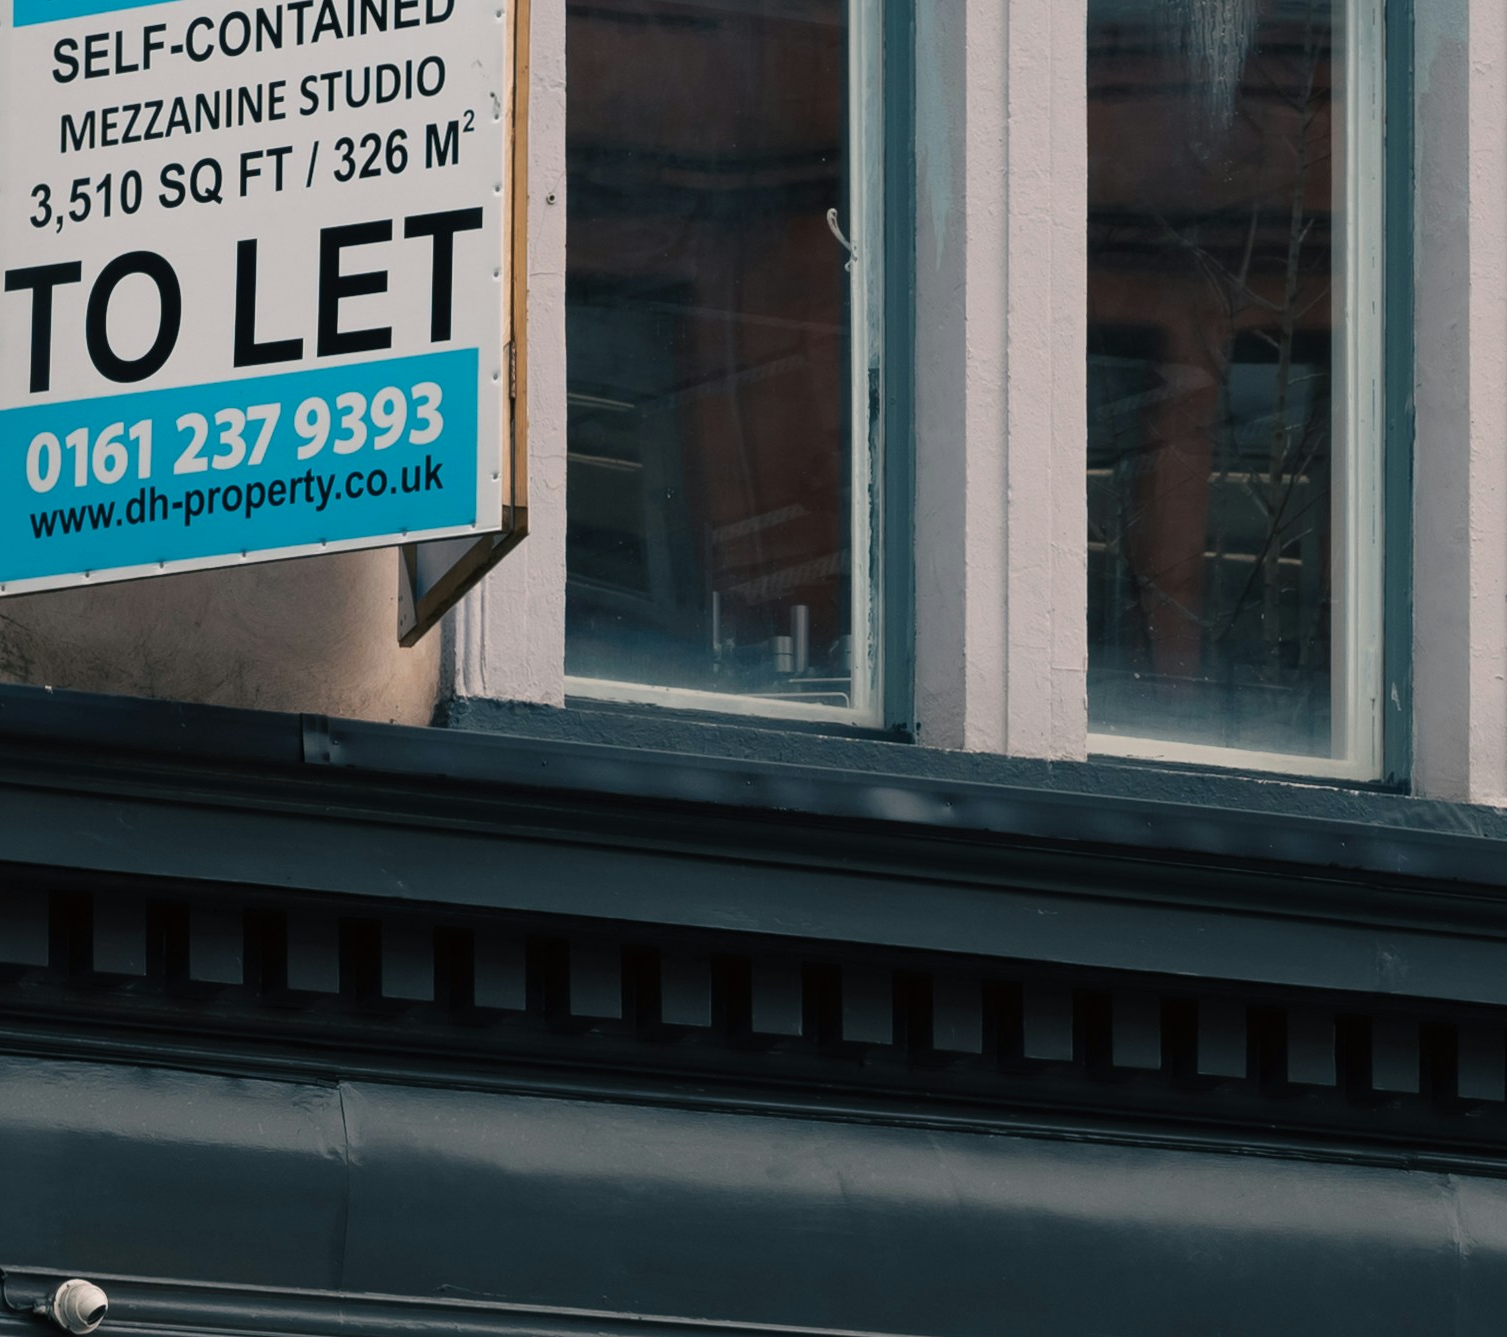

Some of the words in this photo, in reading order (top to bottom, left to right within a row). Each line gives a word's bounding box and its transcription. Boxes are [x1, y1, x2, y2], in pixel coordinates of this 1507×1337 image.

[52, 0, 454, 84] SELF-CONTAINED
[60, 80, 287, 154] MEZZANINE
[299, 55, 446, 116] STUDIO
[29, 169, 143, 234] 3,510
[158, 157, 224, 210] SQ
[239, 145, 293, 198] FT
[305, 141, 320, 188] /
[333, 128, 409, 183] 326
[4, 250, 182, 394] TO
[233, 206, 484, 369] LET
[25, 418, 153, 494] 0161
[173, 402, 282, 475] 237
[293, 381, 445, 461] 9393
[29, 454, 444, 540] www.dh-property.co.uk
